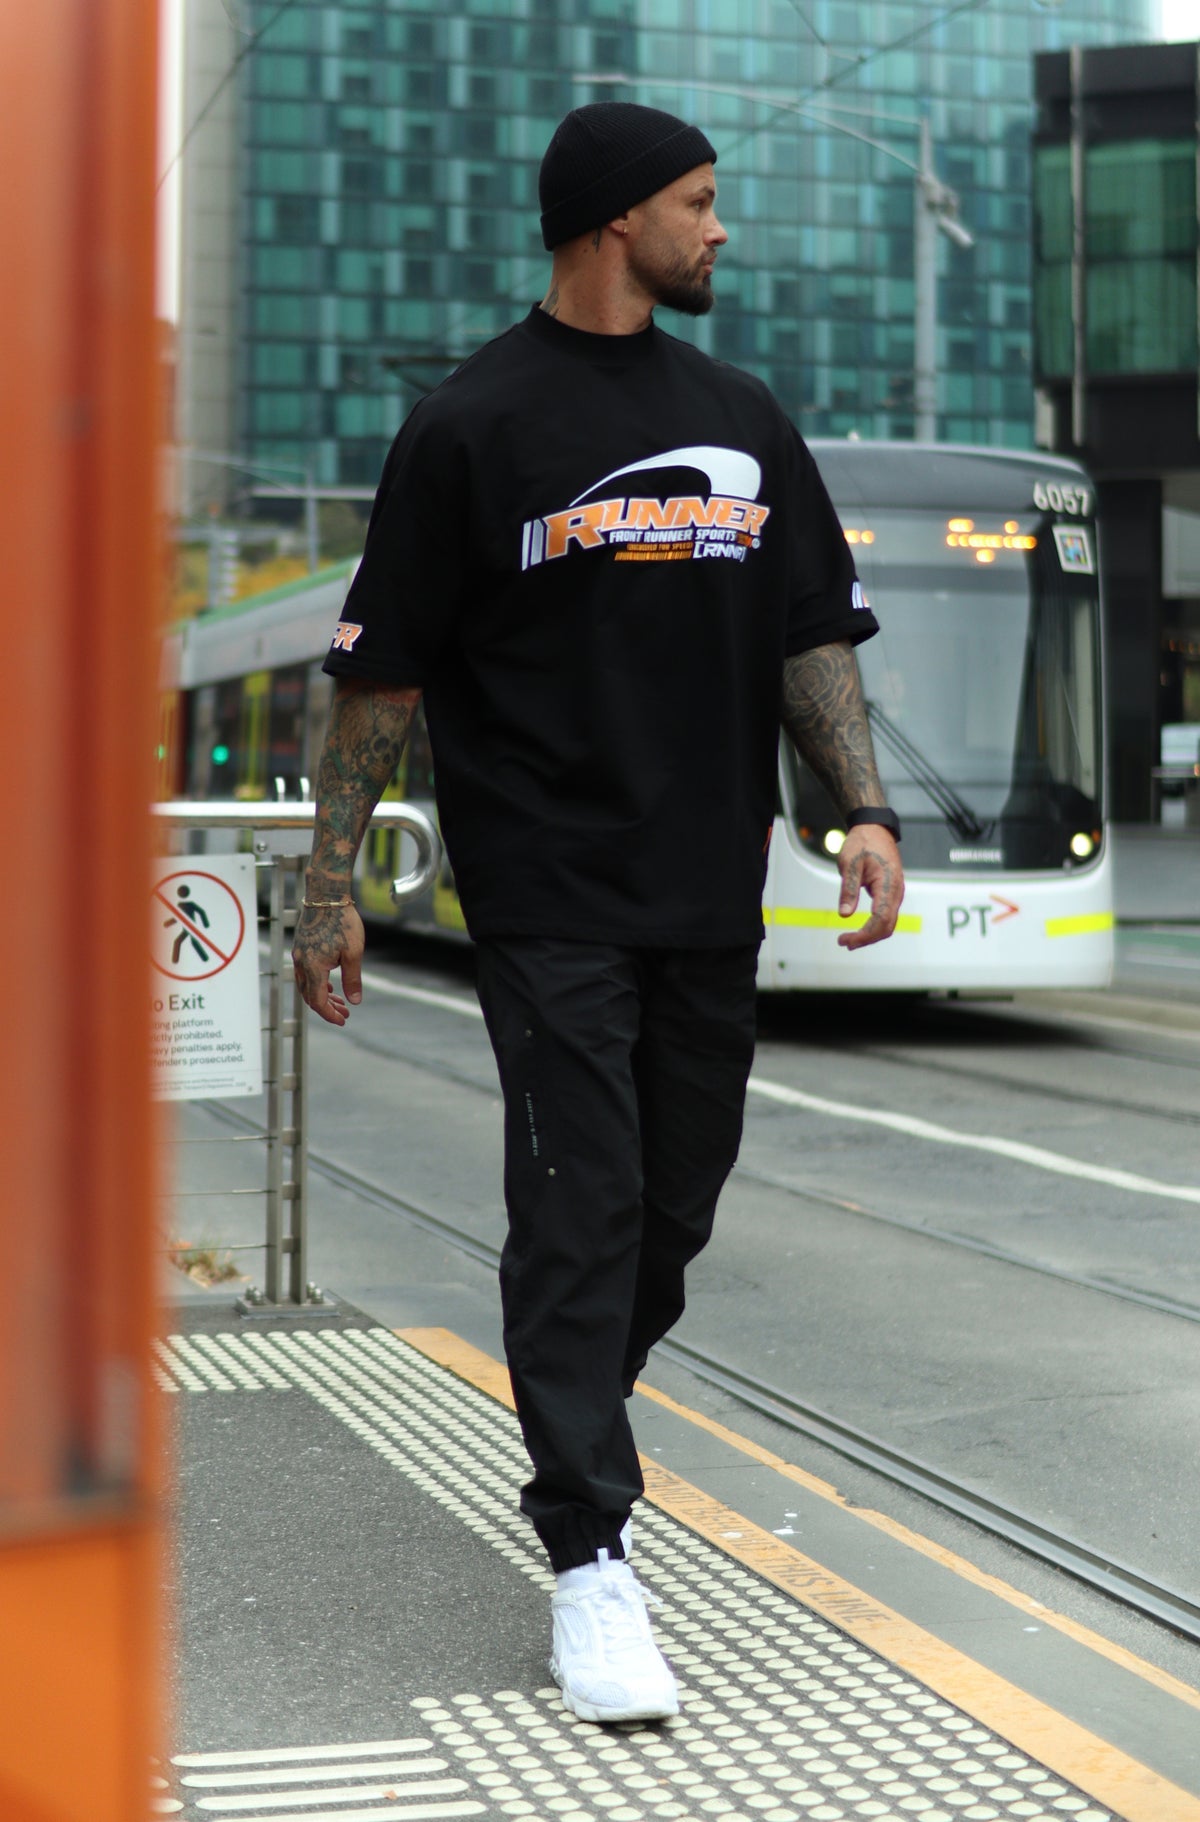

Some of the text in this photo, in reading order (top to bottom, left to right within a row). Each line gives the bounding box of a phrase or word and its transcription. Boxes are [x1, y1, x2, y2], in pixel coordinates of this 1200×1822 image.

[1033, 482, 1089, 517] 6057
[544, 496, 770, 560] RUNNER
[609, 528, 737, 543] FRONT RUNNER SPORTS
[947, 904, 992, 938] PT
[168, 993, 206, 1011] Exit
[172, 1018, 214, 1030] platform
[174, 1029, 224, 1042] prohibited.
[170, 1043, 213, 1055] penalties
[215, 1041, 243, 1053] apply.
[189, 1053, 246, 1067] prosecuted.
[753, 1554, 835, 1588] THIS
[807, 1591, 893, 1624] LINE
